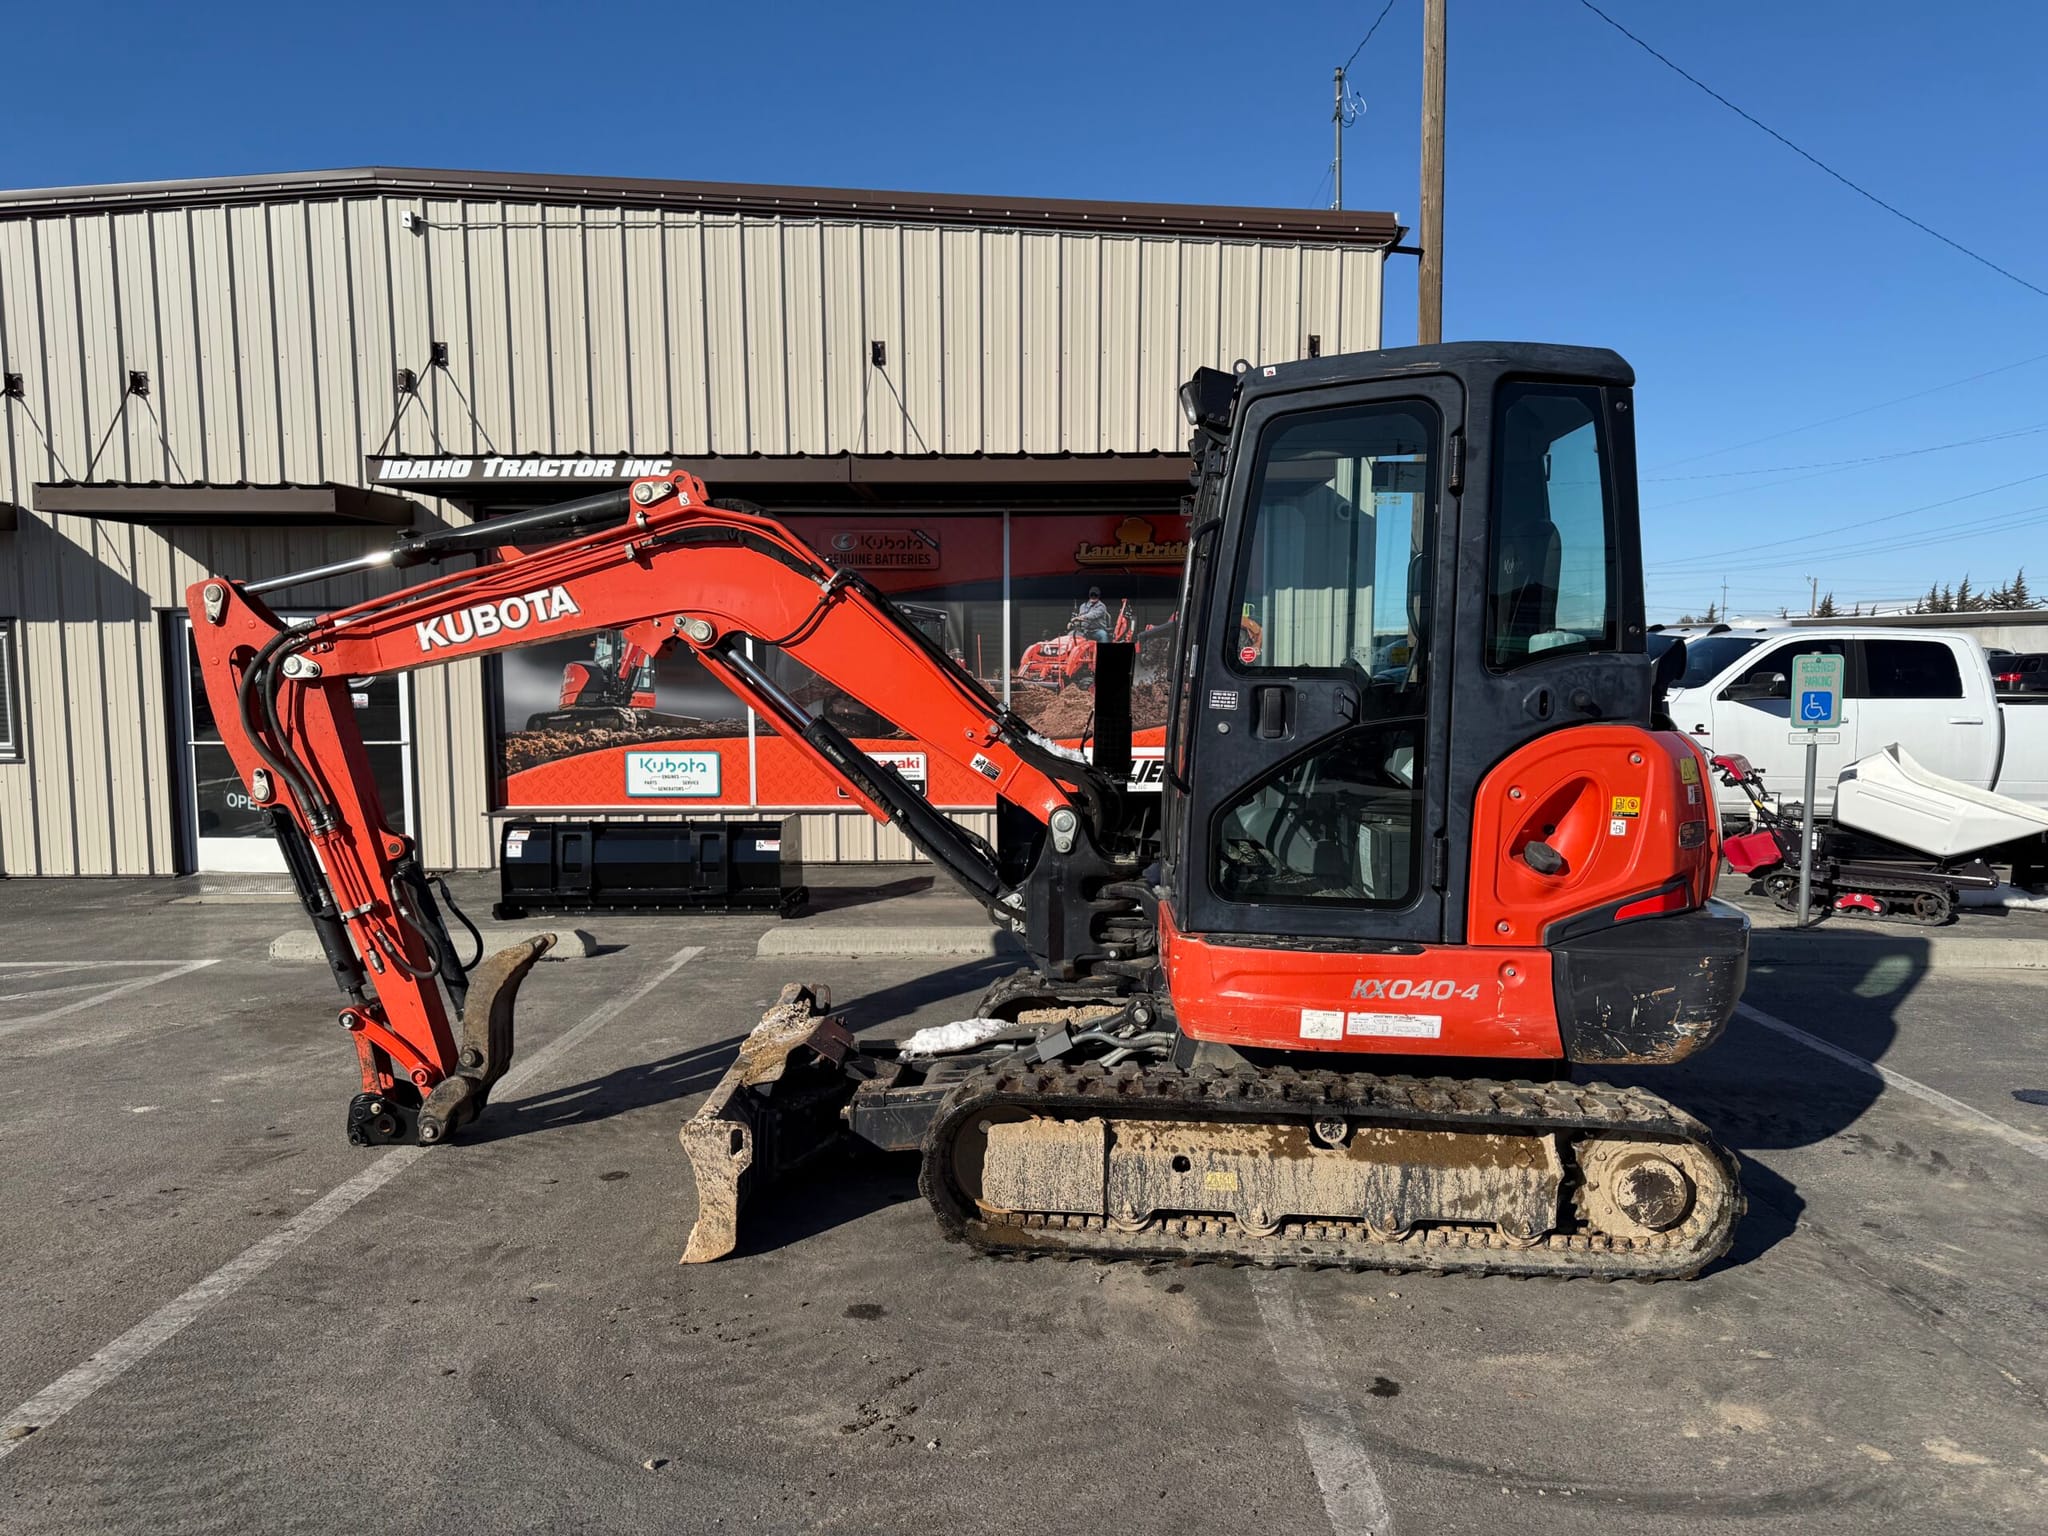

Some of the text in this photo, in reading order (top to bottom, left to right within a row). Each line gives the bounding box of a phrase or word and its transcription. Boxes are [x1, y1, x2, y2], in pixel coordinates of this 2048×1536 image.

[379, 457, 672, 479] IDAHO TRACTOR INC
[861, 535, 924, 550] Kubota
[1079, 541, 1189, 556] Land Pride
[875, 553, 931, 565] BATTERIES
[415, 586, 579, 651] KUBOTA
[640, 758, 707, 773] Kubota
[227, 792, 260, 811] OPE
[1350, 979, 1480, 1000] KX040-4
